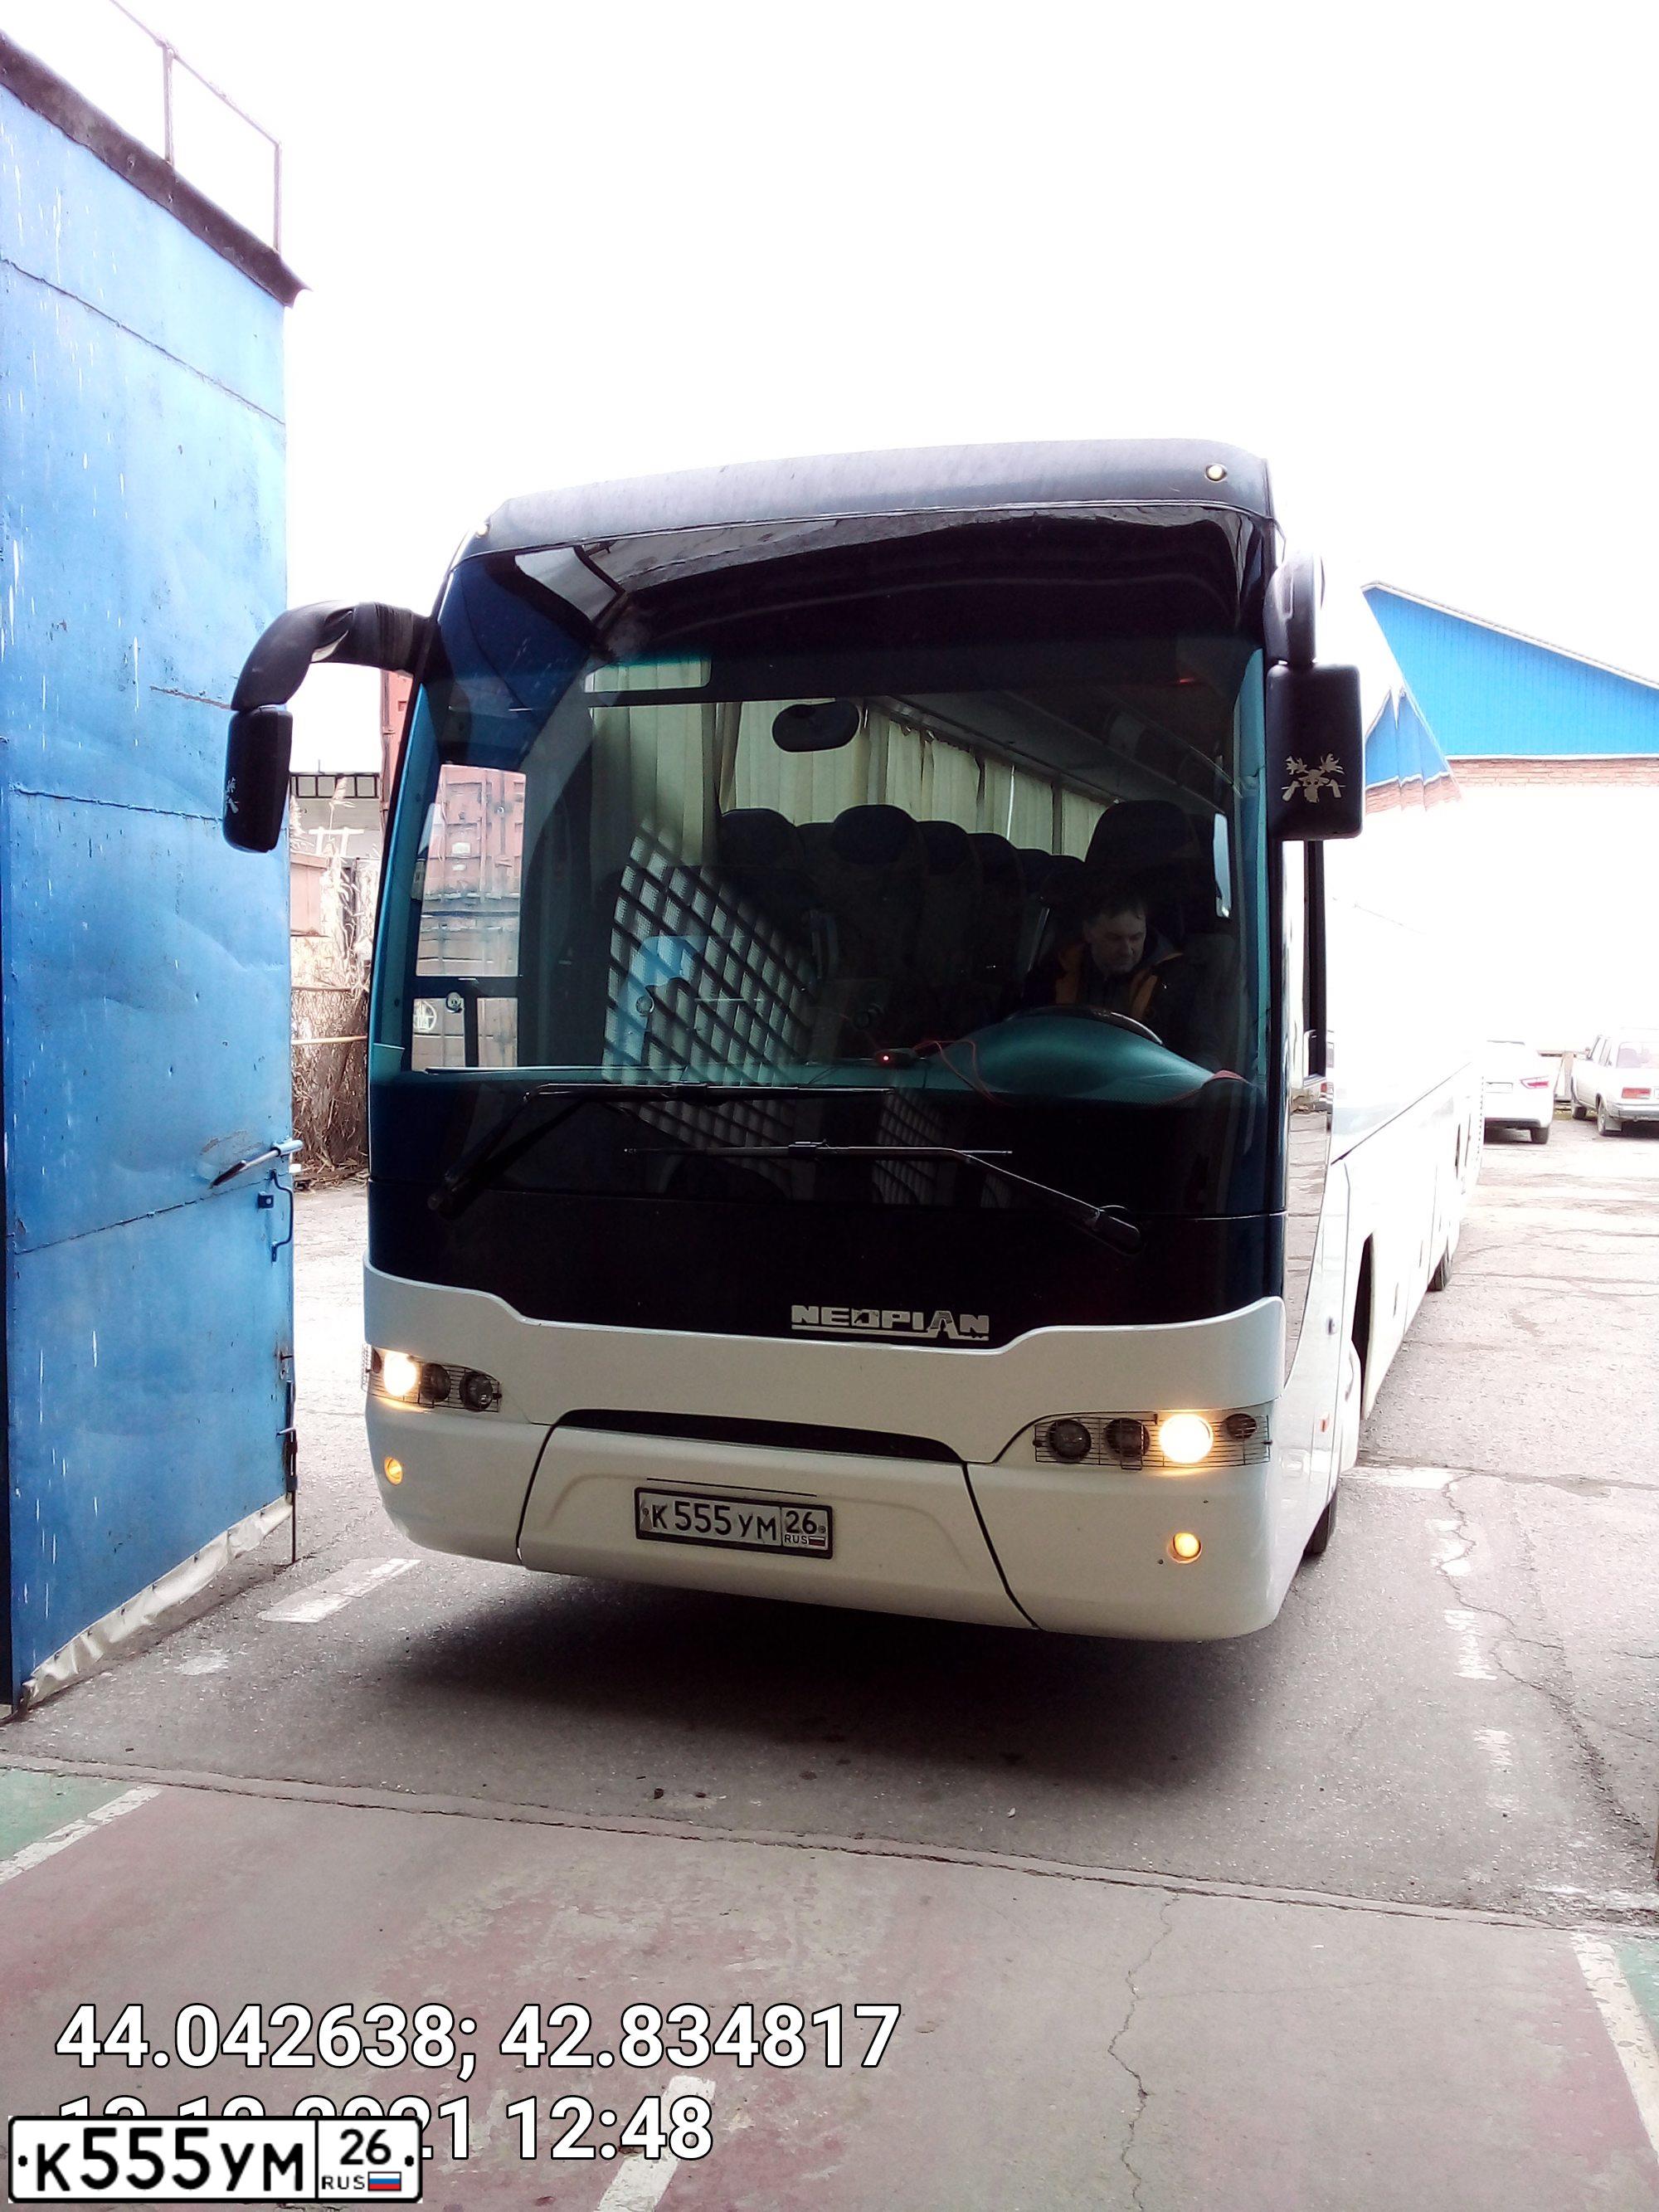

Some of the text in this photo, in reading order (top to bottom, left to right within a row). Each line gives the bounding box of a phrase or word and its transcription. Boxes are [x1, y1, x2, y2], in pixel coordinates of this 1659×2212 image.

[791, 1304, 990, 1338] NEOPLAN
[785, 1510, 818, 1535] 26
[784, 1533, 808, 1544] RUS
